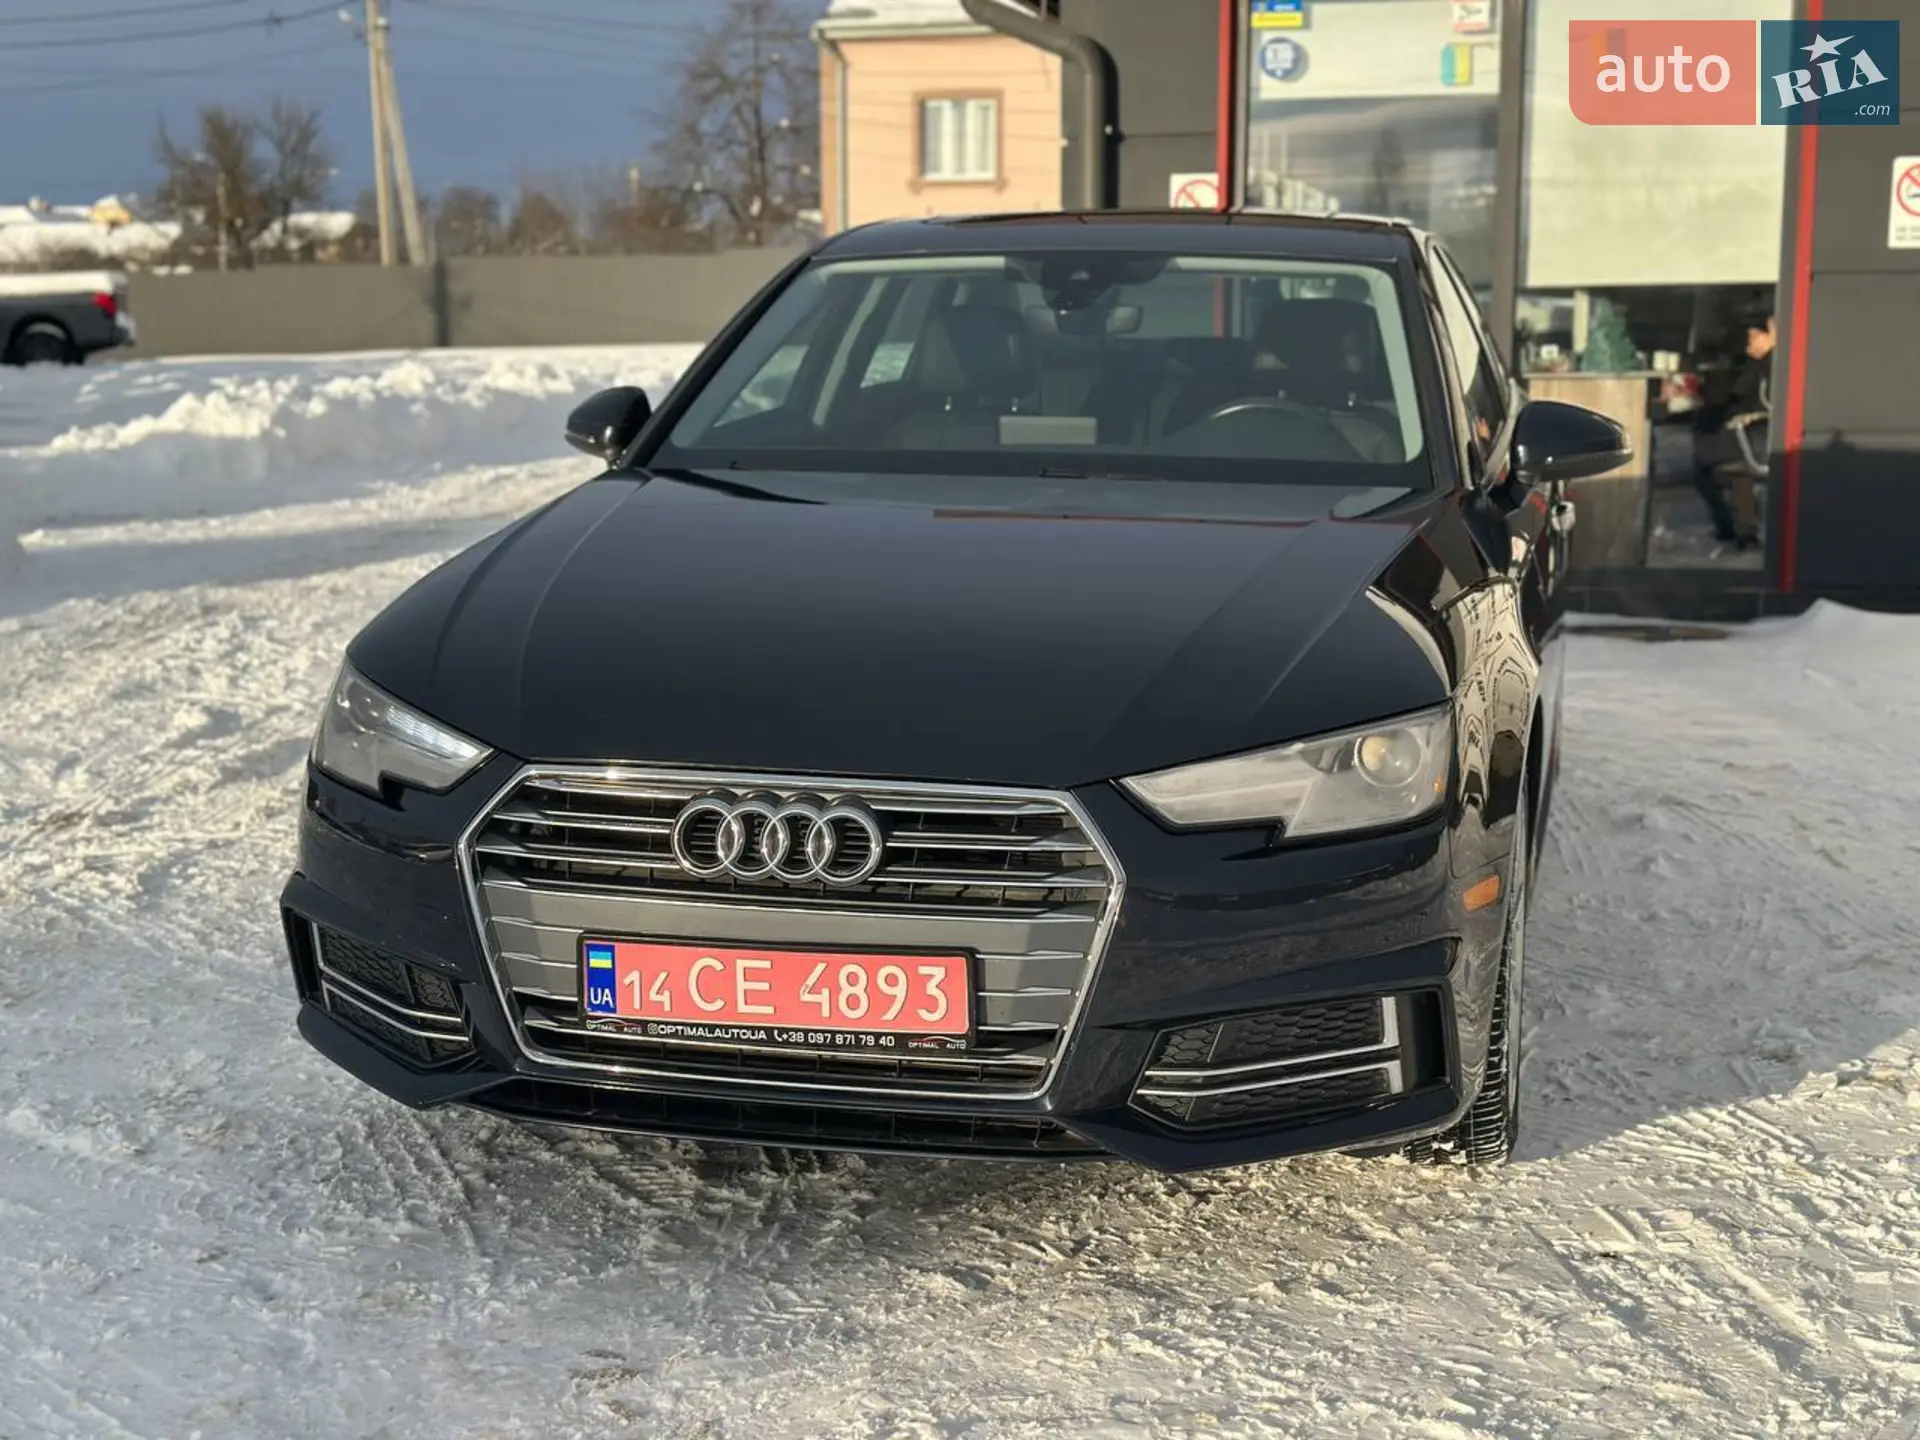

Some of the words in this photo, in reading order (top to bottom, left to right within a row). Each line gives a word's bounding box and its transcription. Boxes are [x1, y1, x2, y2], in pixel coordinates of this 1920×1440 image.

[623, 970, 673, 1012] 14
[688, 957, 777, 1015] CE
[800, 962, 949, 1022] 4893
[590, 987, 614, 1008] UA
[586, 1021, 617, 1032] OPTIMAL
[658, 1025, 767, 1039] OPTIMALAUTOUA
[808, 1033, 831, 1044] 097
[835, 1034, 855, 1046] 871
[859, 1035, 875, 1047] 79
[878, 1036, 895, 1047] 40
[908, 1041, 939, 1049] OPTIMAL
[946, 1040, 967, 1050] AUTO
